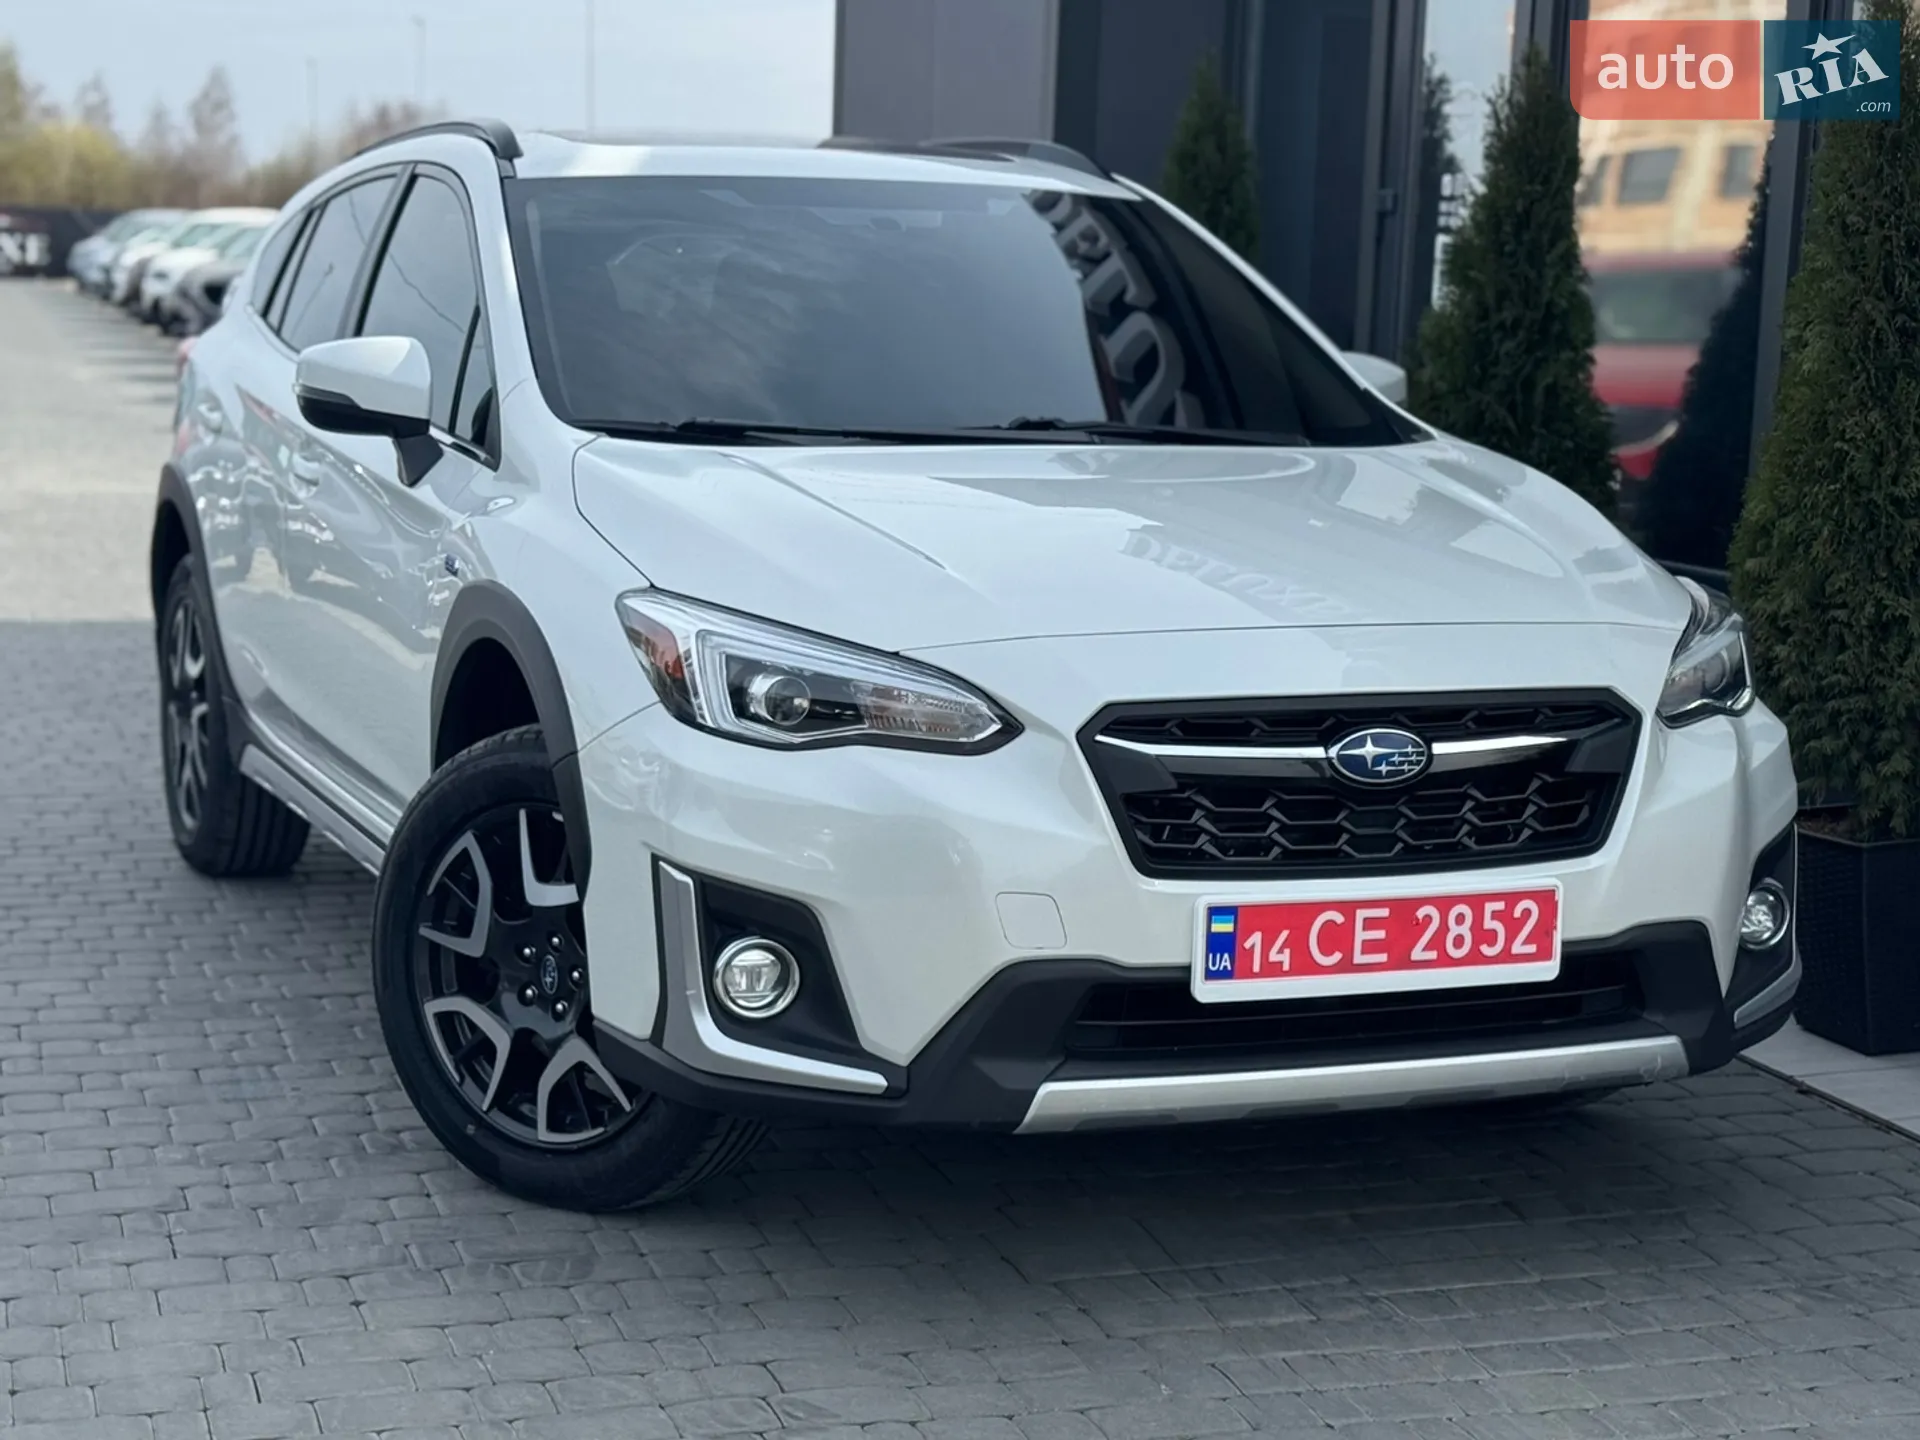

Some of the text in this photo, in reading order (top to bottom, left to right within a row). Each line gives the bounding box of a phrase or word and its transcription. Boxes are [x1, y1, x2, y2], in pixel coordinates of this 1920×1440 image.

[1243, 899, 1540, 973] 14 CE 2852
[1208, 952, 1232, 971] UA
